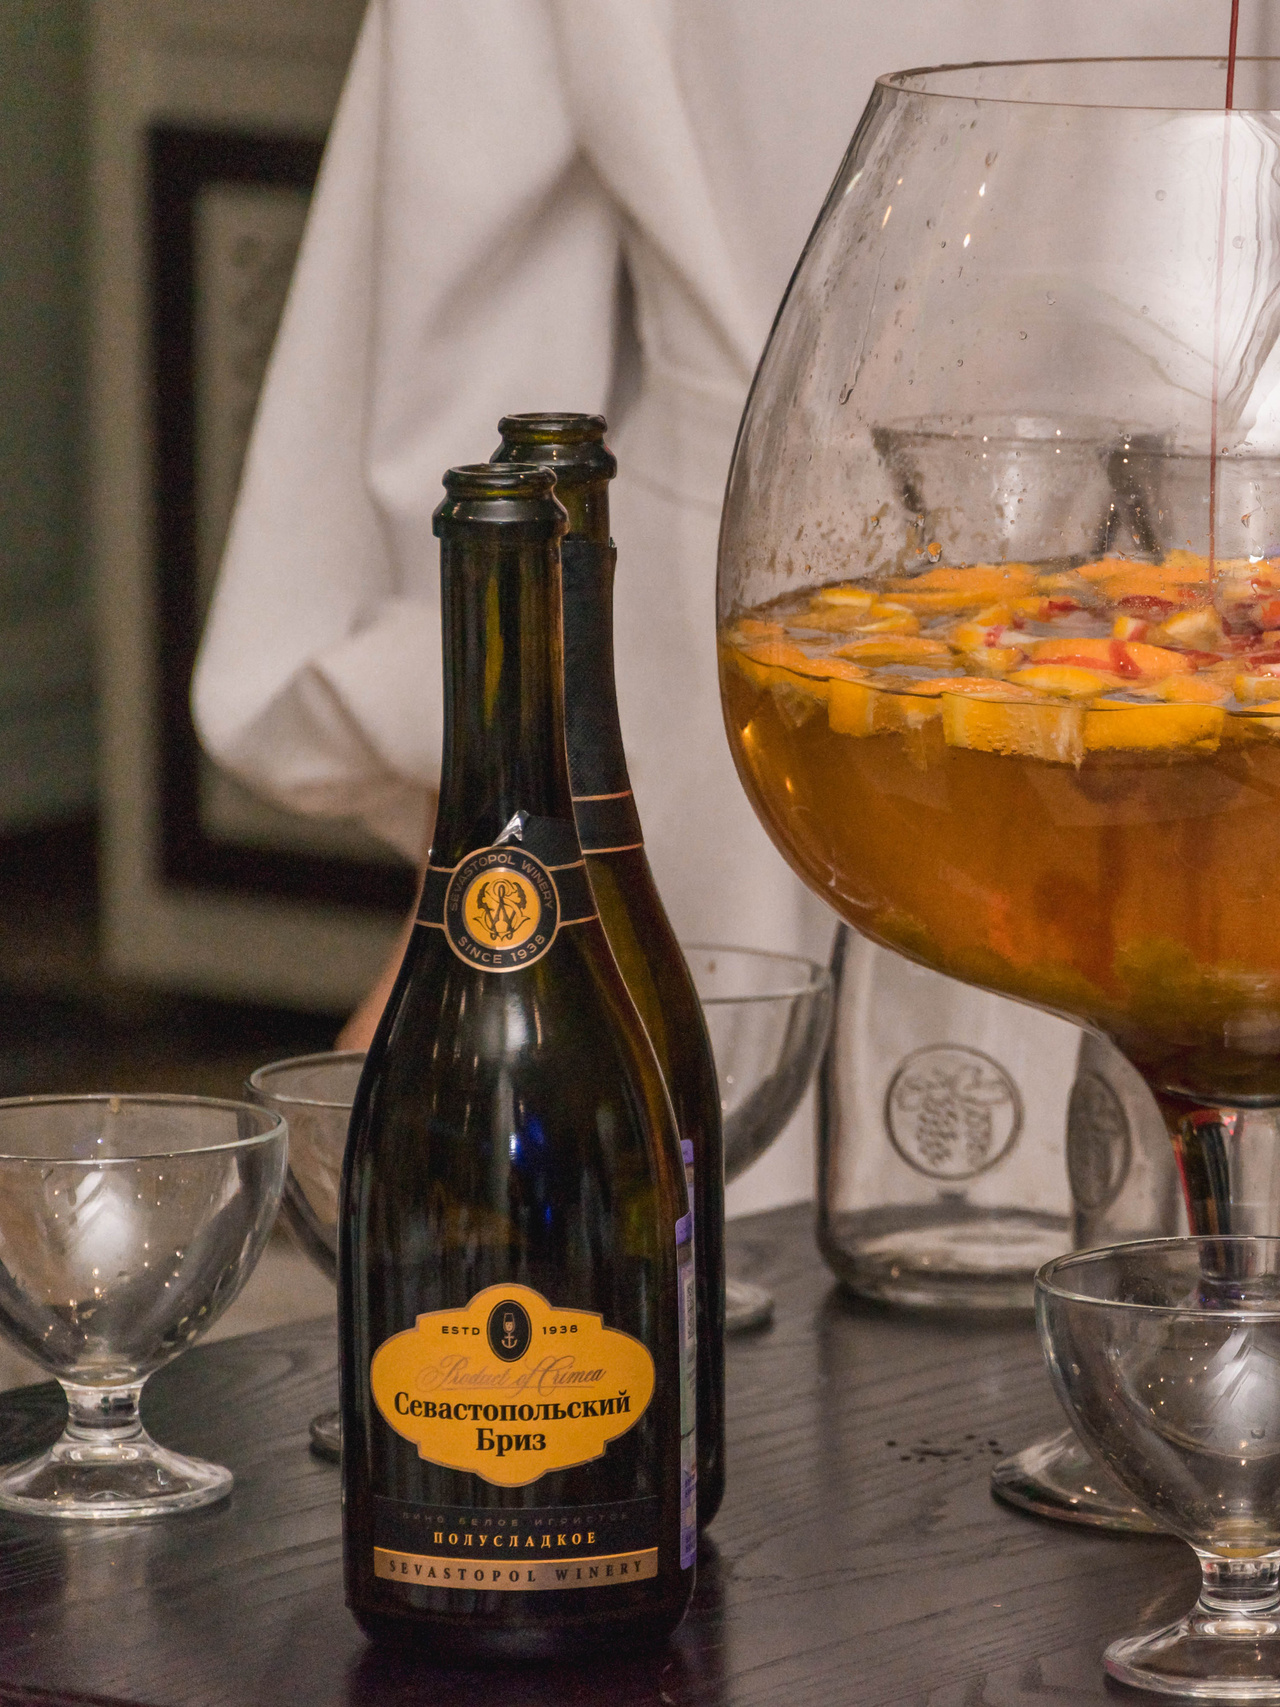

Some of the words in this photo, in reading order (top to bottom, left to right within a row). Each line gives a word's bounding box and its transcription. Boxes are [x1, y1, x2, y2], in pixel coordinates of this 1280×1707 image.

[451, 853, 515, 912] SEVASTOPOL
[521, 859, 553, 910] WINERY
[457, 936, 502, 964] SINCE
[510, 934, 546, 962] 1938
[441, 1325, 481, 1336] ESTD
[542, 1324, 579, 1336] 1938
[536, 1355, 607, 1397] Crimea
[394, 1389, 631, 1421] Севастопольский
[475, 1427, 547, 1457] Бриз
[433, 1531, 597, 1550] ПОЛУСЛАДКОЕ
[389, 1559, 537, 1583] SEVASTOPOL
[555, 1559, 643, 1581] WINERY
